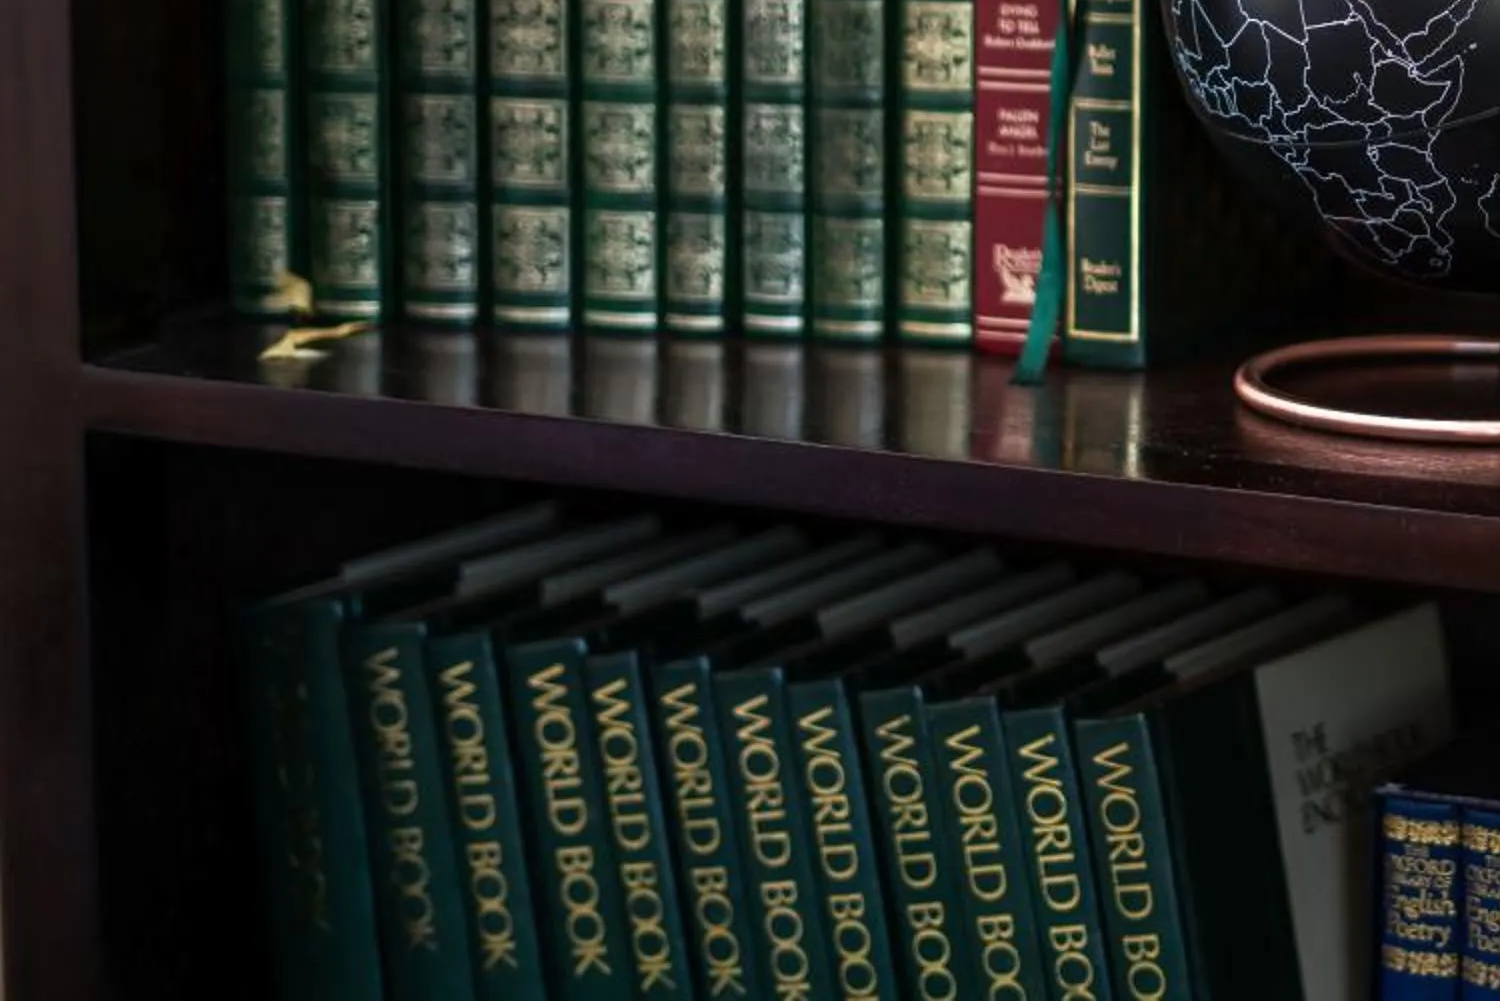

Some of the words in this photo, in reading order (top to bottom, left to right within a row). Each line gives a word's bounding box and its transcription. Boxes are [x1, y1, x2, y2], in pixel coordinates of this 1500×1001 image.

[439, 660, 496, 830] WORLD
[527, 663, 589, 835] WORLD
[592, 678, 651, 850] WORLD
[660, 683, 721, 855] WORLD
[733, 694, 792, 868] WORLD
[875, 714, 938, 890] WORLD
[945, 725, 1007, 902] WORLD
[1018, 734, 1082, 912] WORLD
[466, 841, 518, 971] BOOK
[556, 844, 611, 976] BOOK
[797, 706, 859, 881] WORLD
[828, 893, 880, 1001] BOO
[1093, 742, 1153, 921] WORLD
[621, 861, 677, 992] BOOK
[690, 866, 747, 997] BOOK
[1049, 924, 1097, 1001] BO
